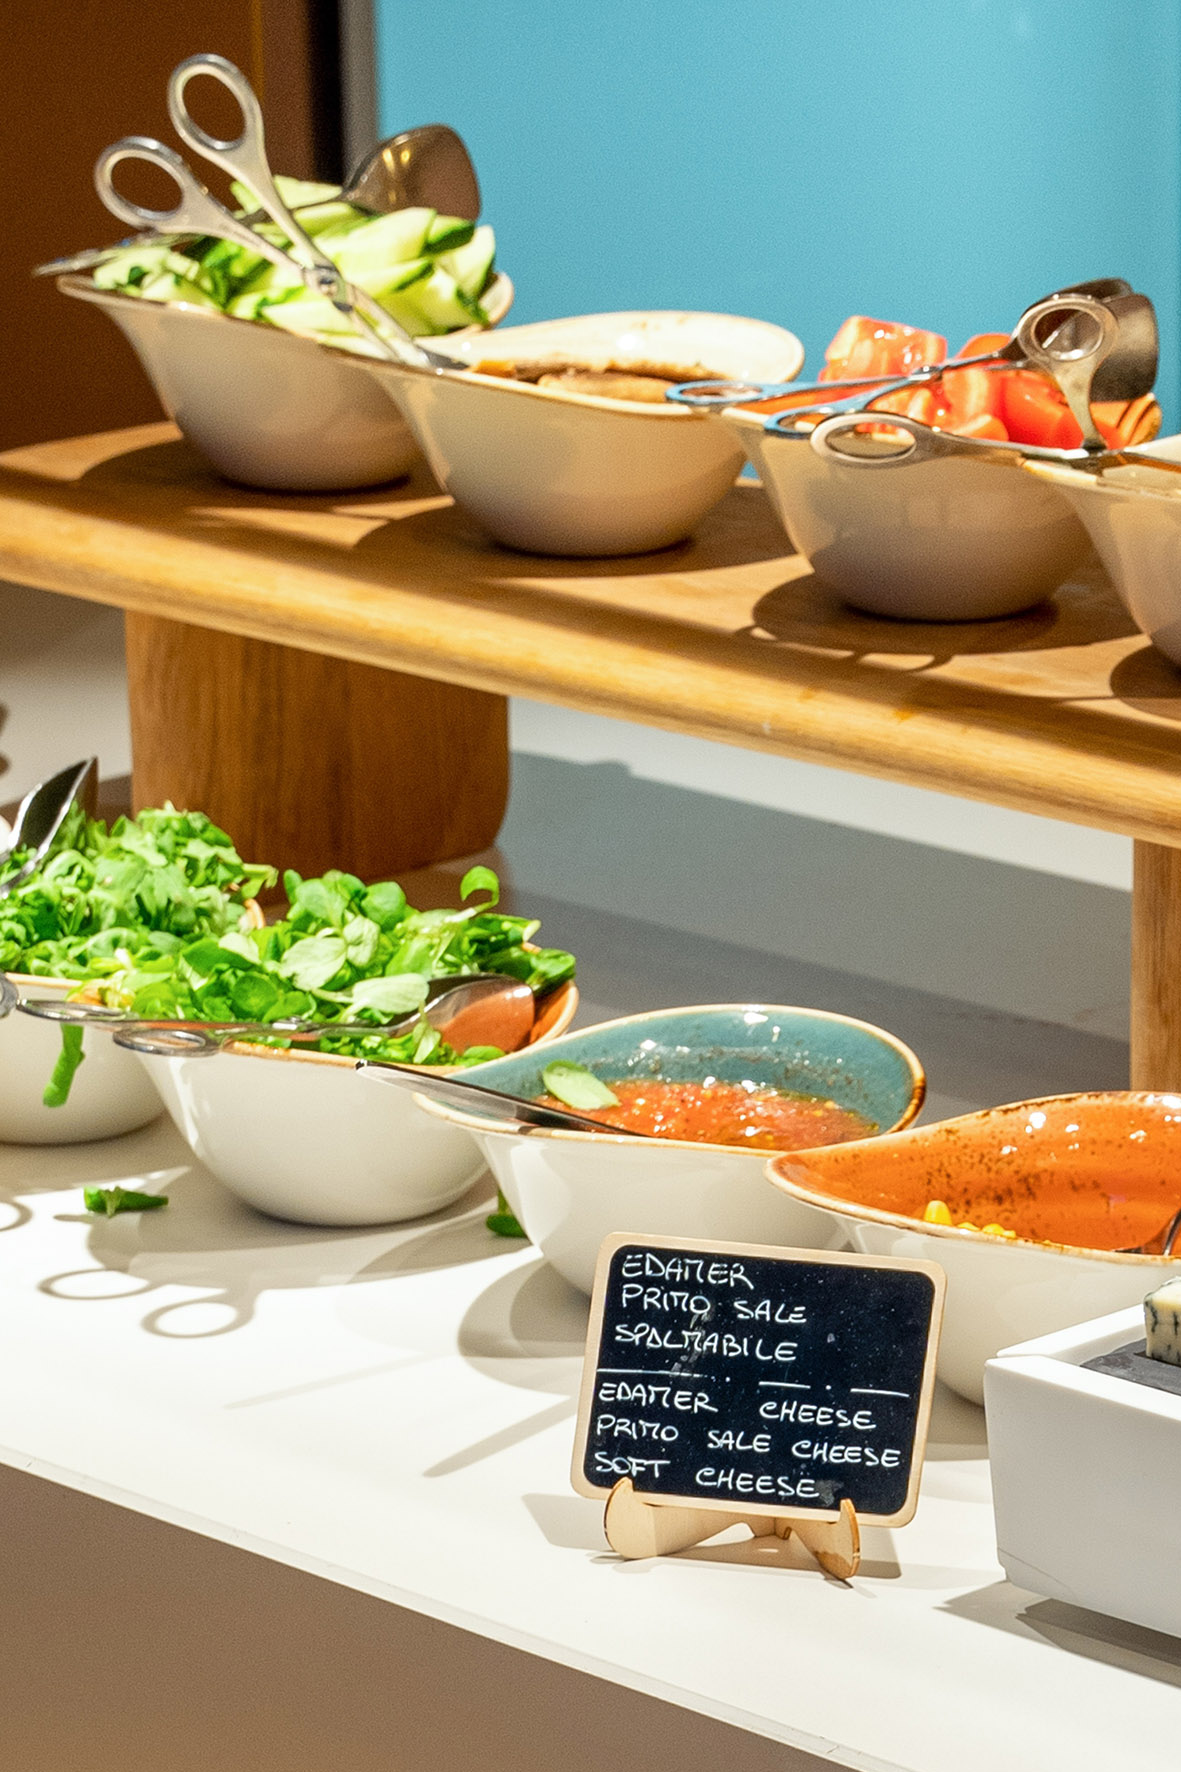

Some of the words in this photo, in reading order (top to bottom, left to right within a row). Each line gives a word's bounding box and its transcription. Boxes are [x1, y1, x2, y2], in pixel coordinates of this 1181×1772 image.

[621, 1252, 754, 1290] EDAMER
[621, 1283, 711, 1315] PRIMO
[732, 1299, 807, 1324] SALE
[614, 1323, 798, 1362] SPALMABILE
[598, 1382, 718, 1413] EDAMER
[758, 1401, 877, 1430] CHEESE
[596, 1414, 679, 1442] PRIMO
[706, 1429, 772, 1452] SALE
[791, 1439, 901, 1468] CHEESE
[594, 1451, 671, 1479] SOFT
[695, 1466, 820, 1499] CHEESE
